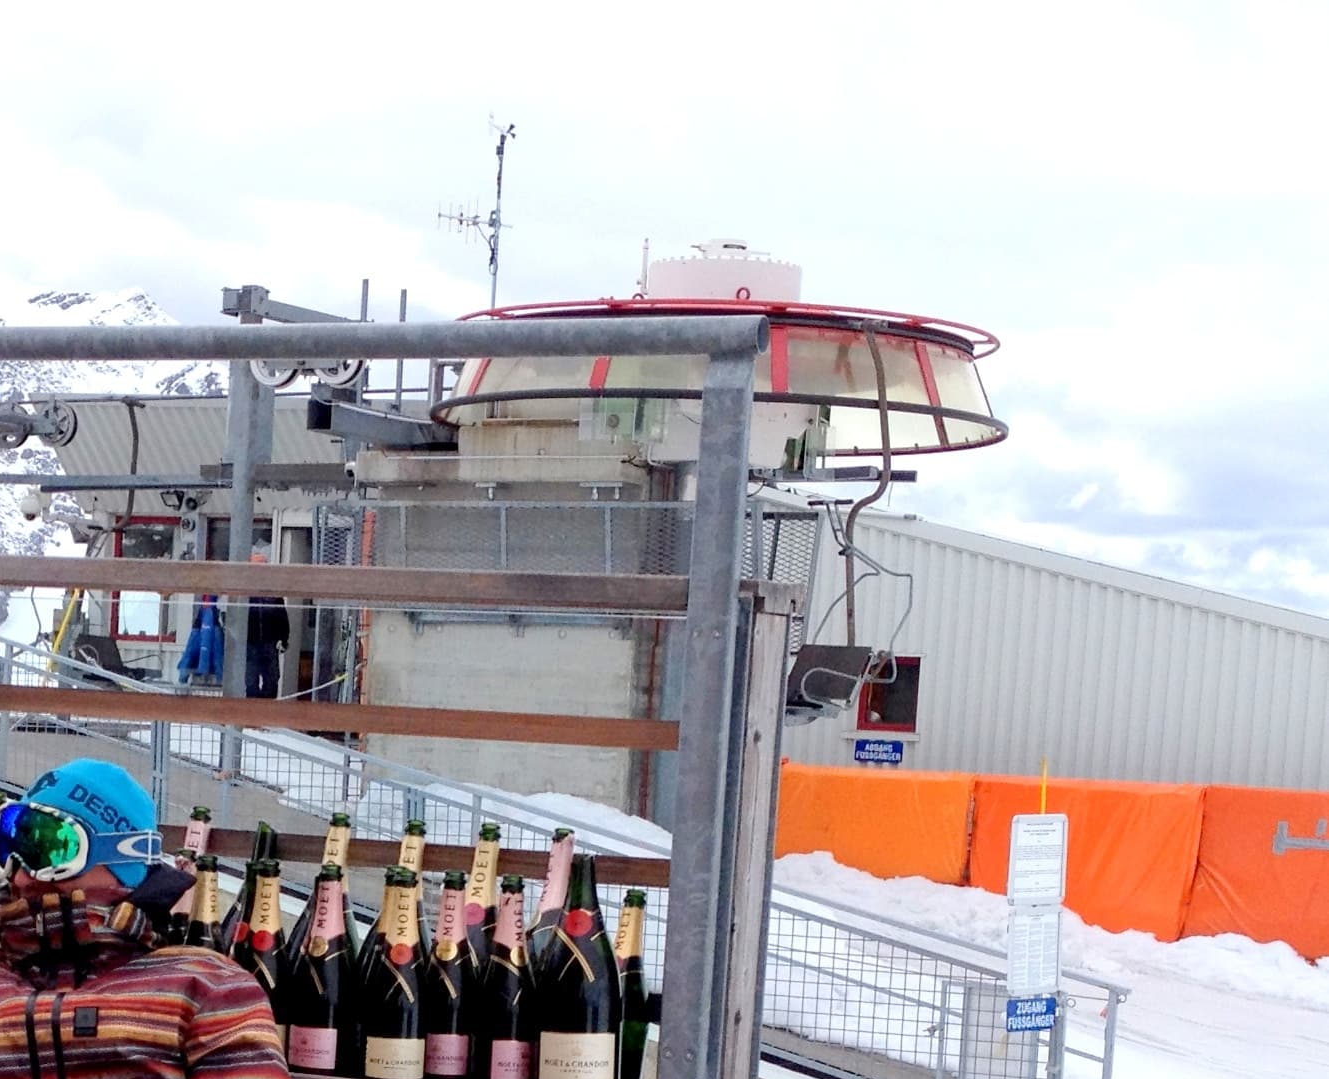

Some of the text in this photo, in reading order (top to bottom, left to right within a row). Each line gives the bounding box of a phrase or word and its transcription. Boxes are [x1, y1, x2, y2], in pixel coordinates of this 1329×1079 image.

[471, 848, 490, 898] MOET
[259, 881, 272, 925] MOET
[316, 885, 331, 929] MOET
[396, 892, 410, 936] MOET
[443, 892, 457, 936] MOET
[1016, 1001, 1047, 1015] ZUGANG
[571, 1059, 609, 1068] CHANDON
